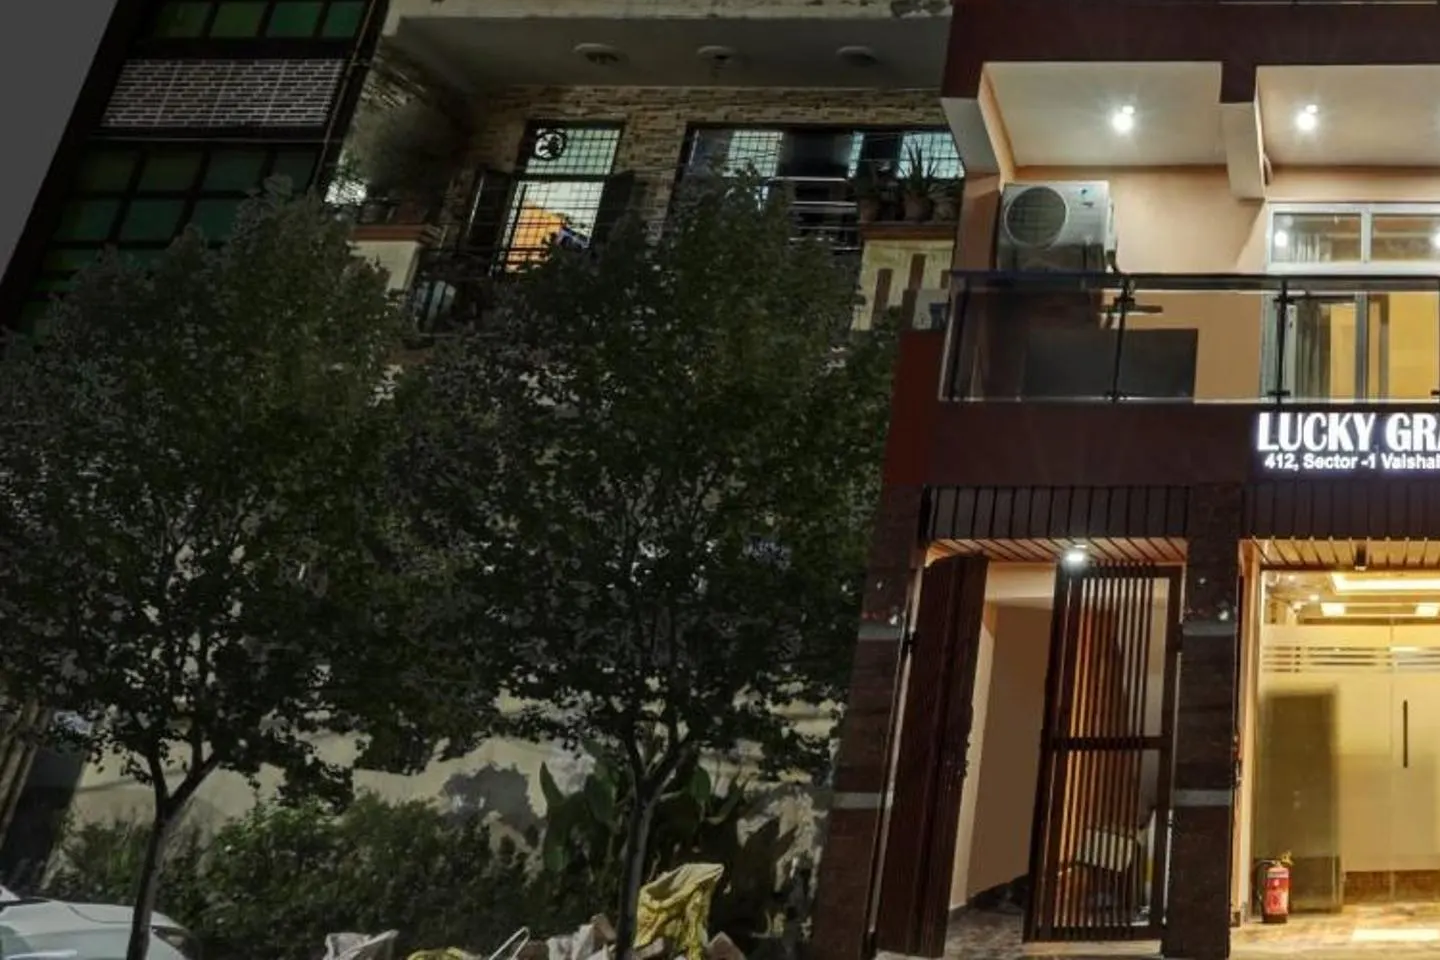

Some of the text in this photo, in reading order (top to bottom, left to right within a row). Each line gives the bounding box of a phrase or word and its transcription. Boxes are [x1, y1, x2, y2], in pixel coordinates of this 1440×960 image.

[1257, 412, 1376, 452] LUCKY
[1264, 453, 1299, 471] 412,
[1303, 453, 1358, 469] Sector
